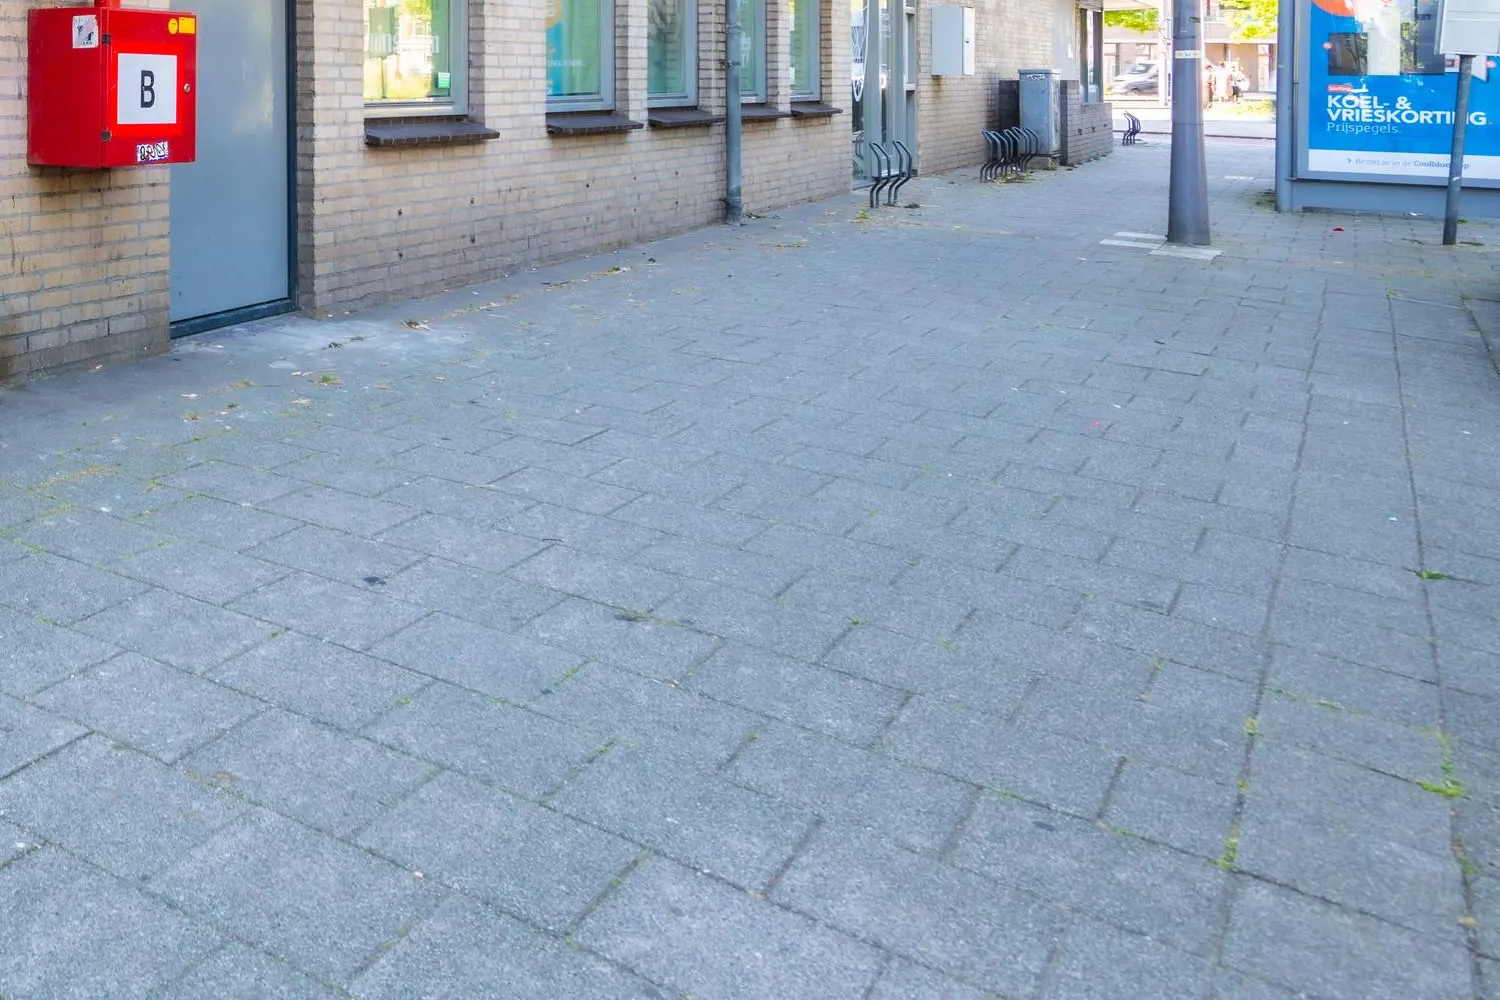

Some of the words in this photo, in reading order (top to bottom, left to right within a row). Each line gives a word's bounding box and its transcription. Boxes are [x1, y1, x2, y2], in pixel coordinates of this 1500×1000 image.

[140, 70, 155, 108] B
[1327, 95, 1389, 109] KOEL-
[1396, 96, 1411, 110] &
